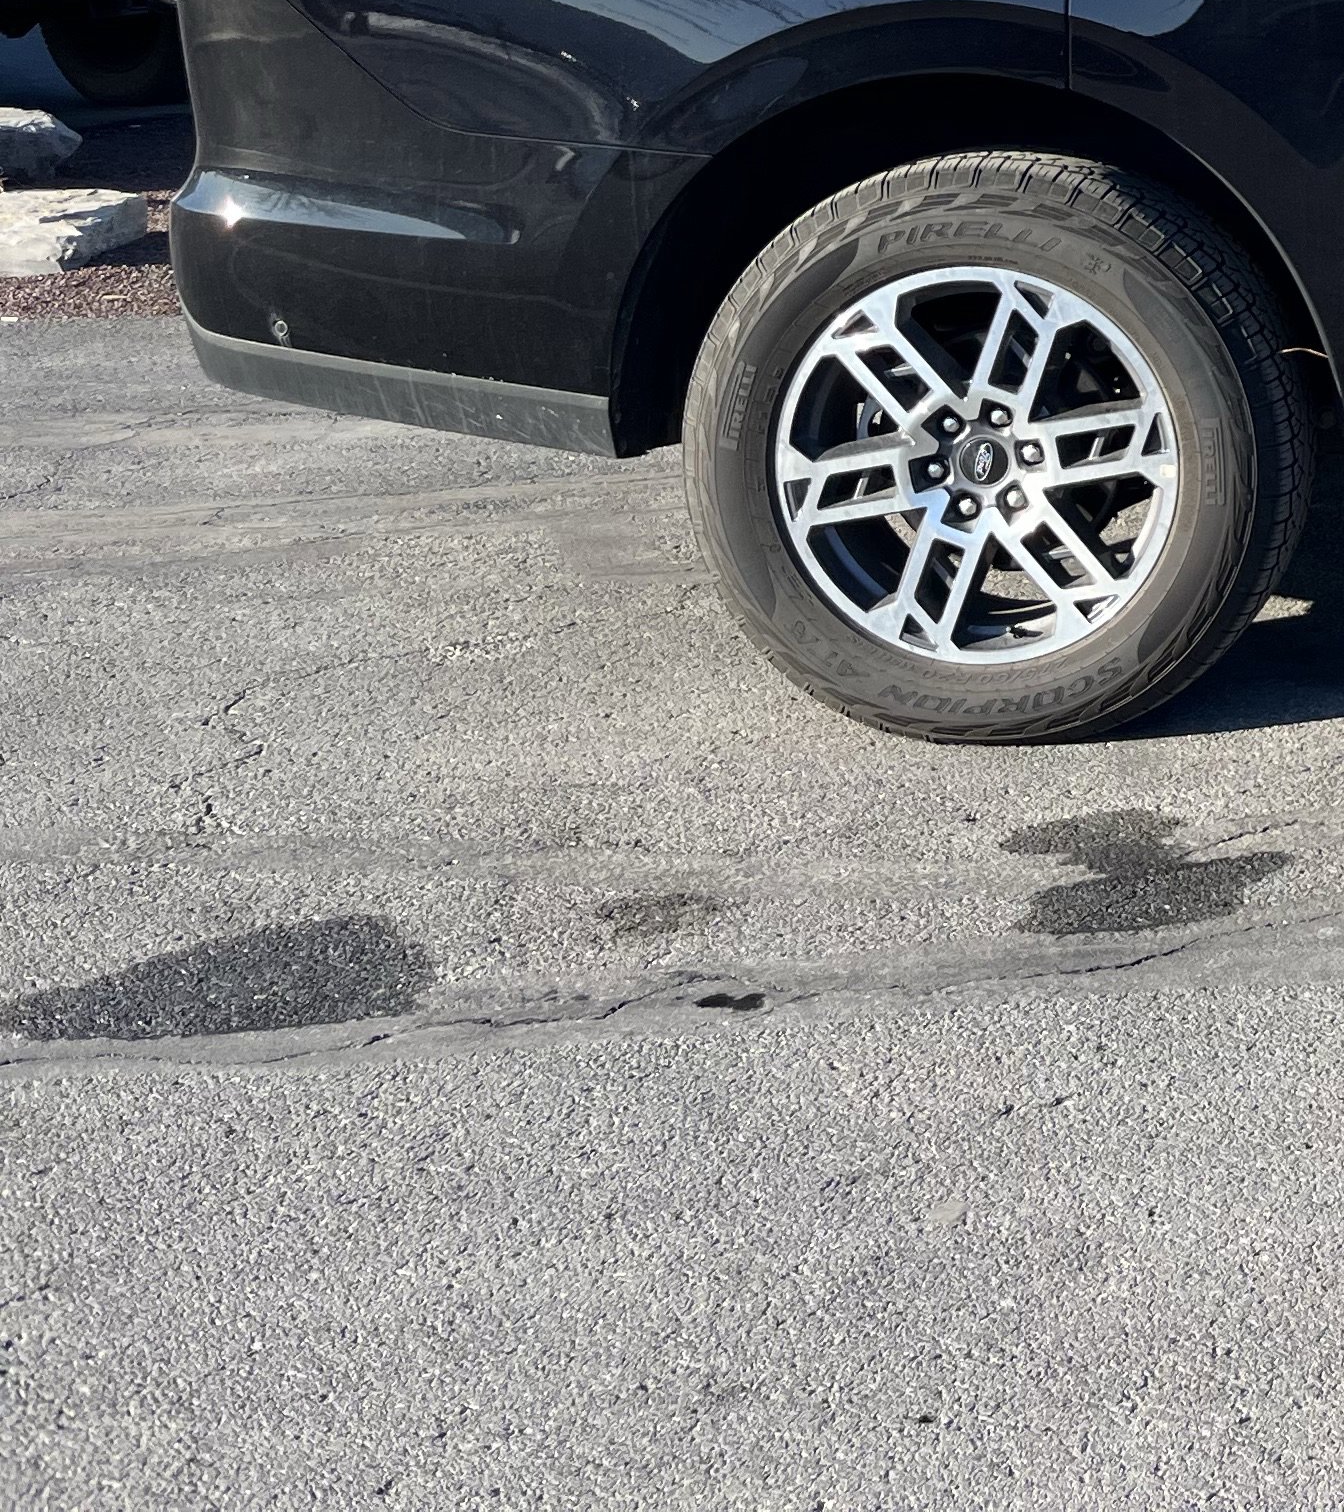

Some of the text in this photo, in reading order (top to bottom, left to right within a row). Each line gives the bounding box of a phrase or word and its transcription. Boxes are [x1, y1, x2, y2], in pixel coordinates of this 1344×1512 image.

[877, 220, 1062, 255] PIRELLI
[719, 365, 758, 452] PIRELLI
[1201, 417, 1225, 506] PIRELLI
[876, 656, 1123, 716] SCORPION
